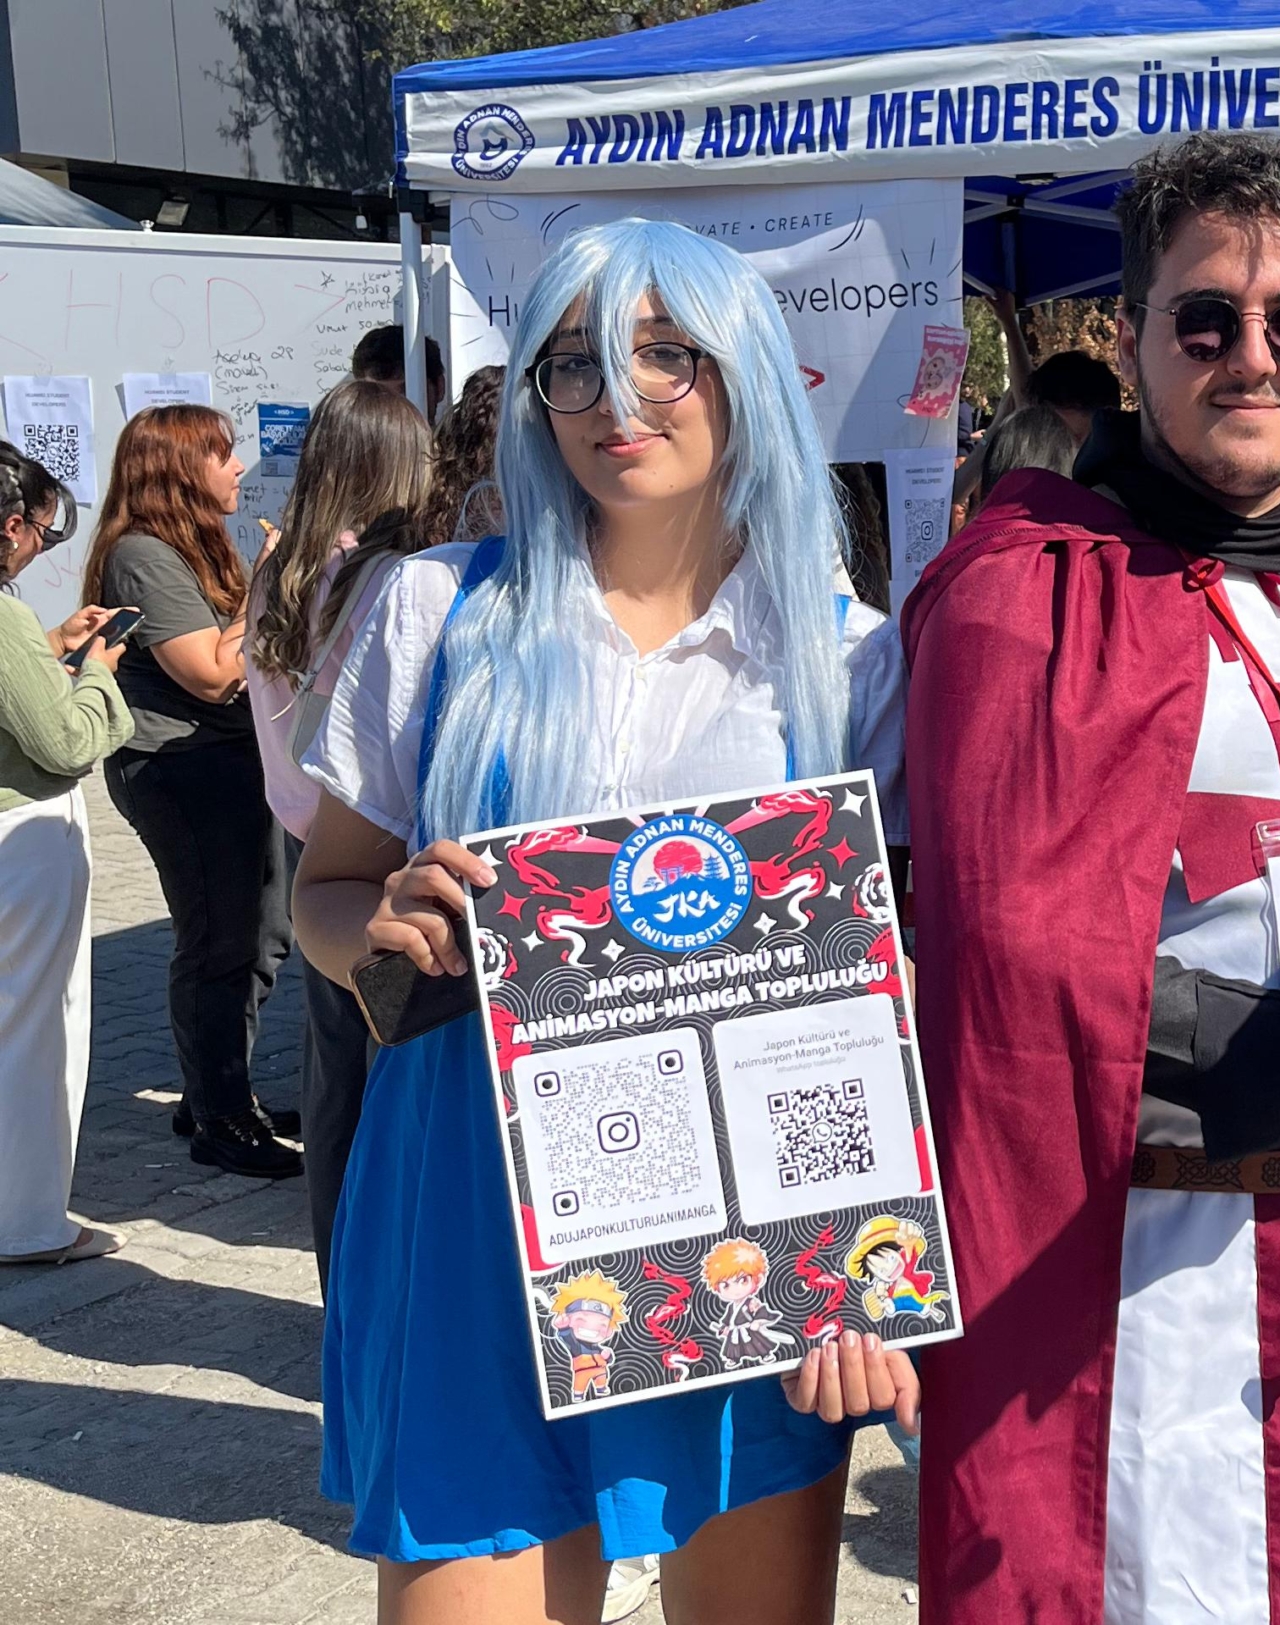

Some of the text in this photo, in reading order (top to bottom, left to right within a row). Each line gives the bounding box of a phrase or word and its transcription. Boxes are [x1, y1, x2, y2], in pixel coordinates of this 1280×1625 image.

[463, 107, 500, 128] ADNAN
[555, 109, 685, 165] AYDIN
[695, 96, 852, 159] ADNAN
[865, 76, 1119, 150] MENDERES
[765, 212, 833, 232] CREATE
[774, 277, 939, 319] evelopers
[614, 818, 748, 913] AYDIN ADNAN MENDERES
[584, 944, 805, 1001] JAPON KÜLTÜRÜ VE
[512, 959, 888, 1045] ANİMASYON-MANGA TOPLULUĞU
[734, 1035, 884, 1070] Animasyon-Manga Topluluğu
[763, 1029, 850, 1051] Japon Kültürü ve
[549, 1204, 717, 1247] ADUJAPONKULTURUANIMANGA
